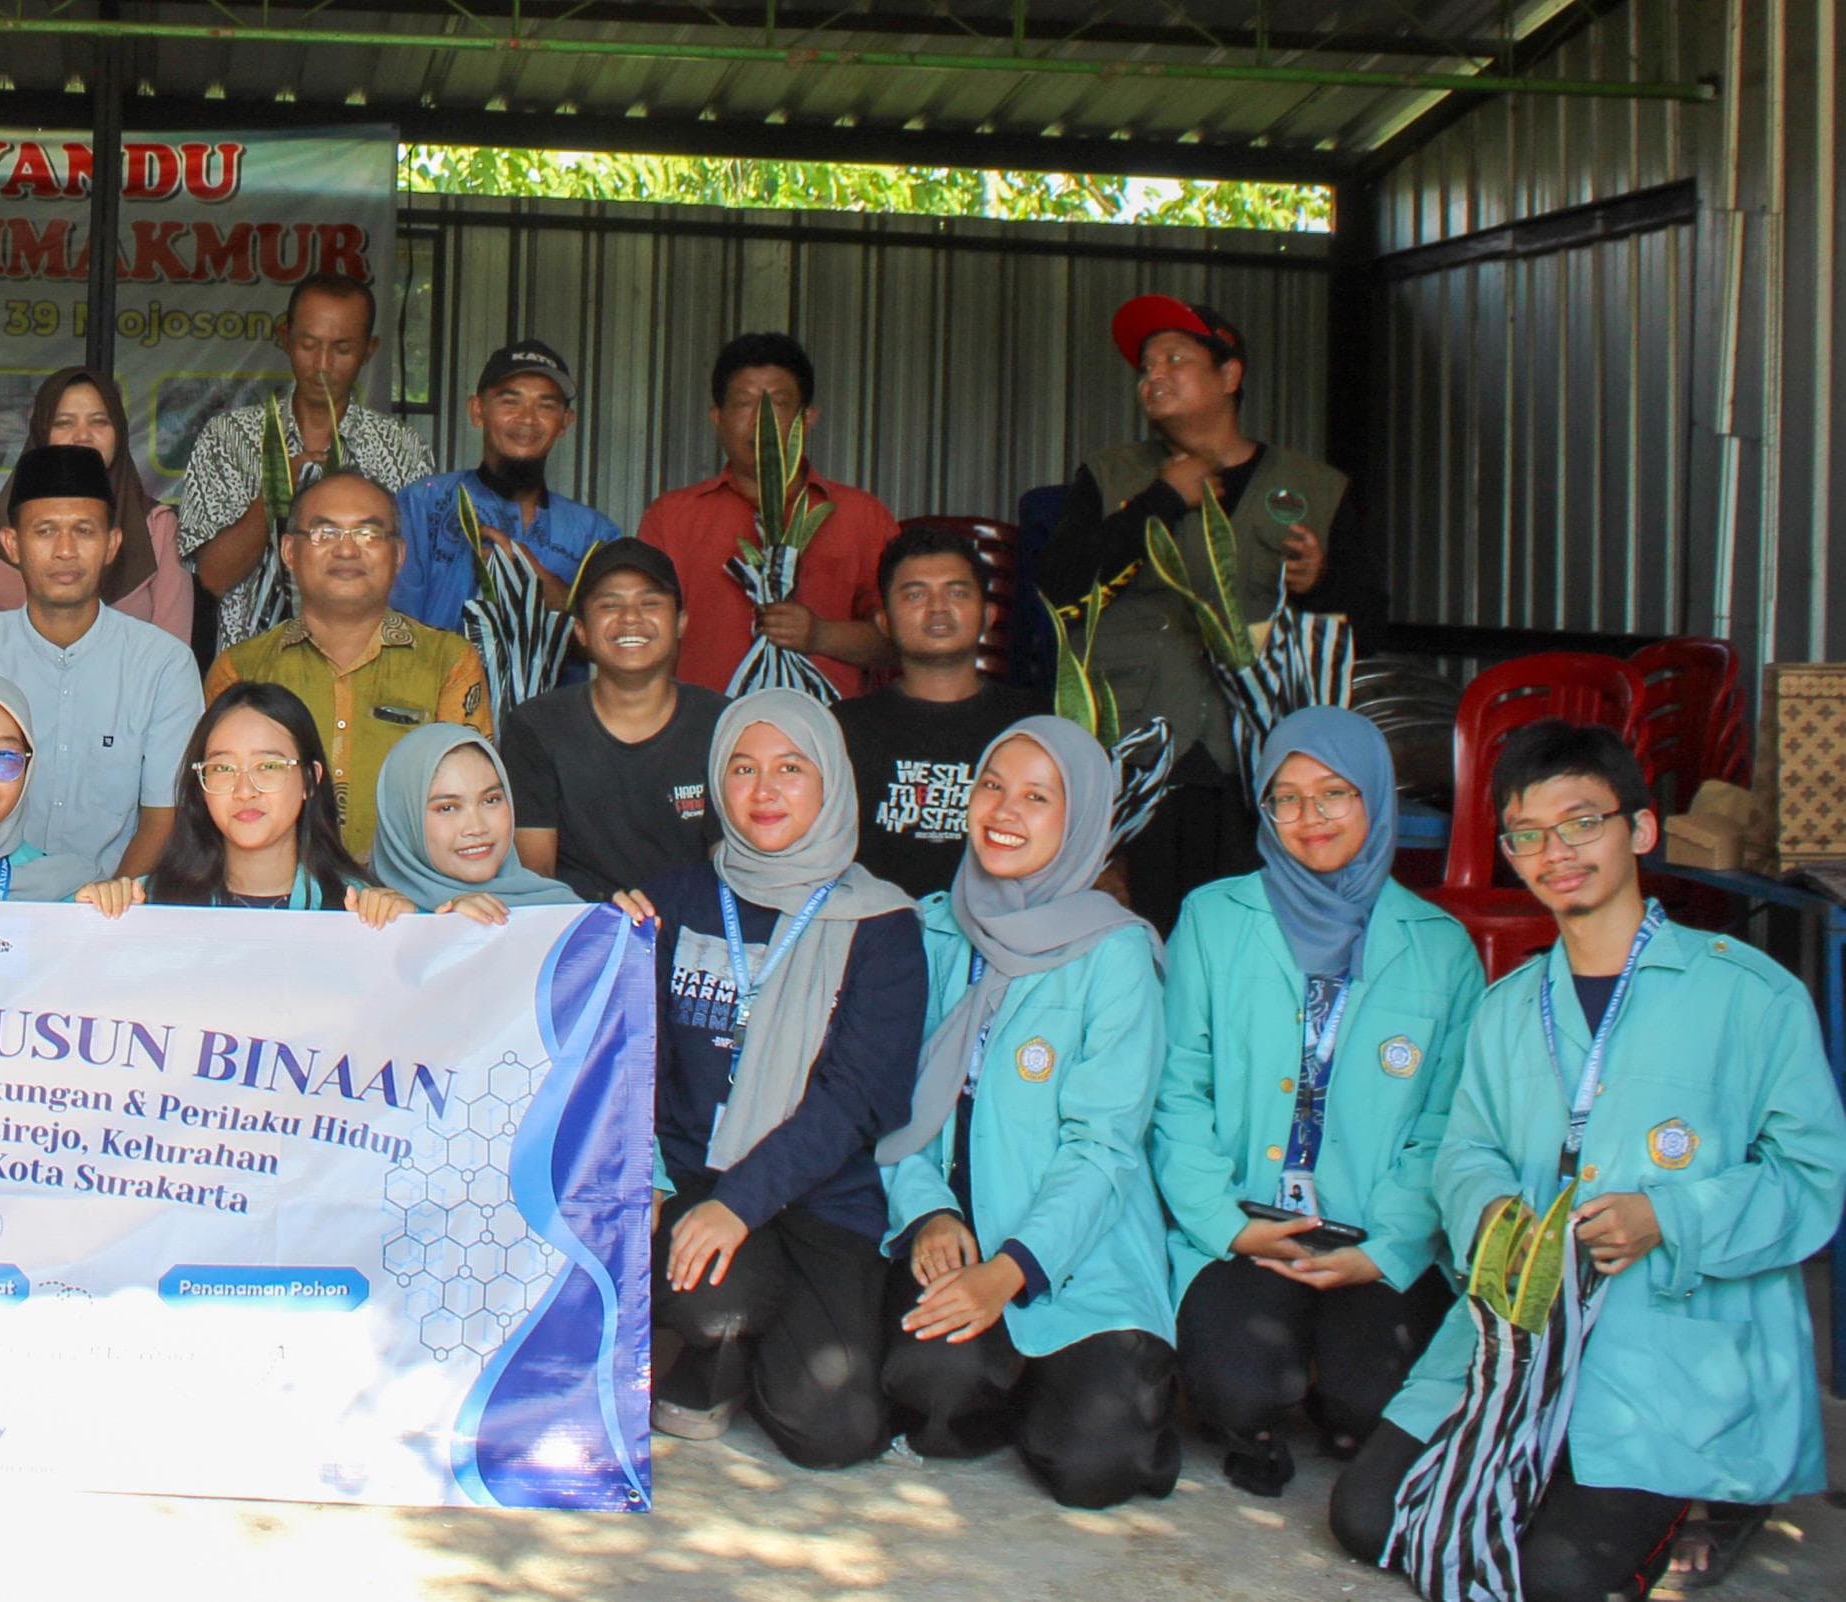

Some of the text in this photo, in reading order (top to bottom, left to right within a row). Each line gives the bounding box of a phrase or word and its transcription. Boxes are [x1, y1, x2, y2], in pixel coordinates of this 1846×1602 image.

[3, 298, 59, 338] 39
[193, 1029, 458, 1121] BINAAN
[100, 1127, 280, 1176] Kelurahan
[123, 1089, 147, 1118] &
[158, 1093, 302, 1137] Perilaku
[309, 1114, 413, 1164] Hidup
[74, 1163, 249, 1214] Surakarta
[179, 1279, 349, 1297] Penanaman Pohon
